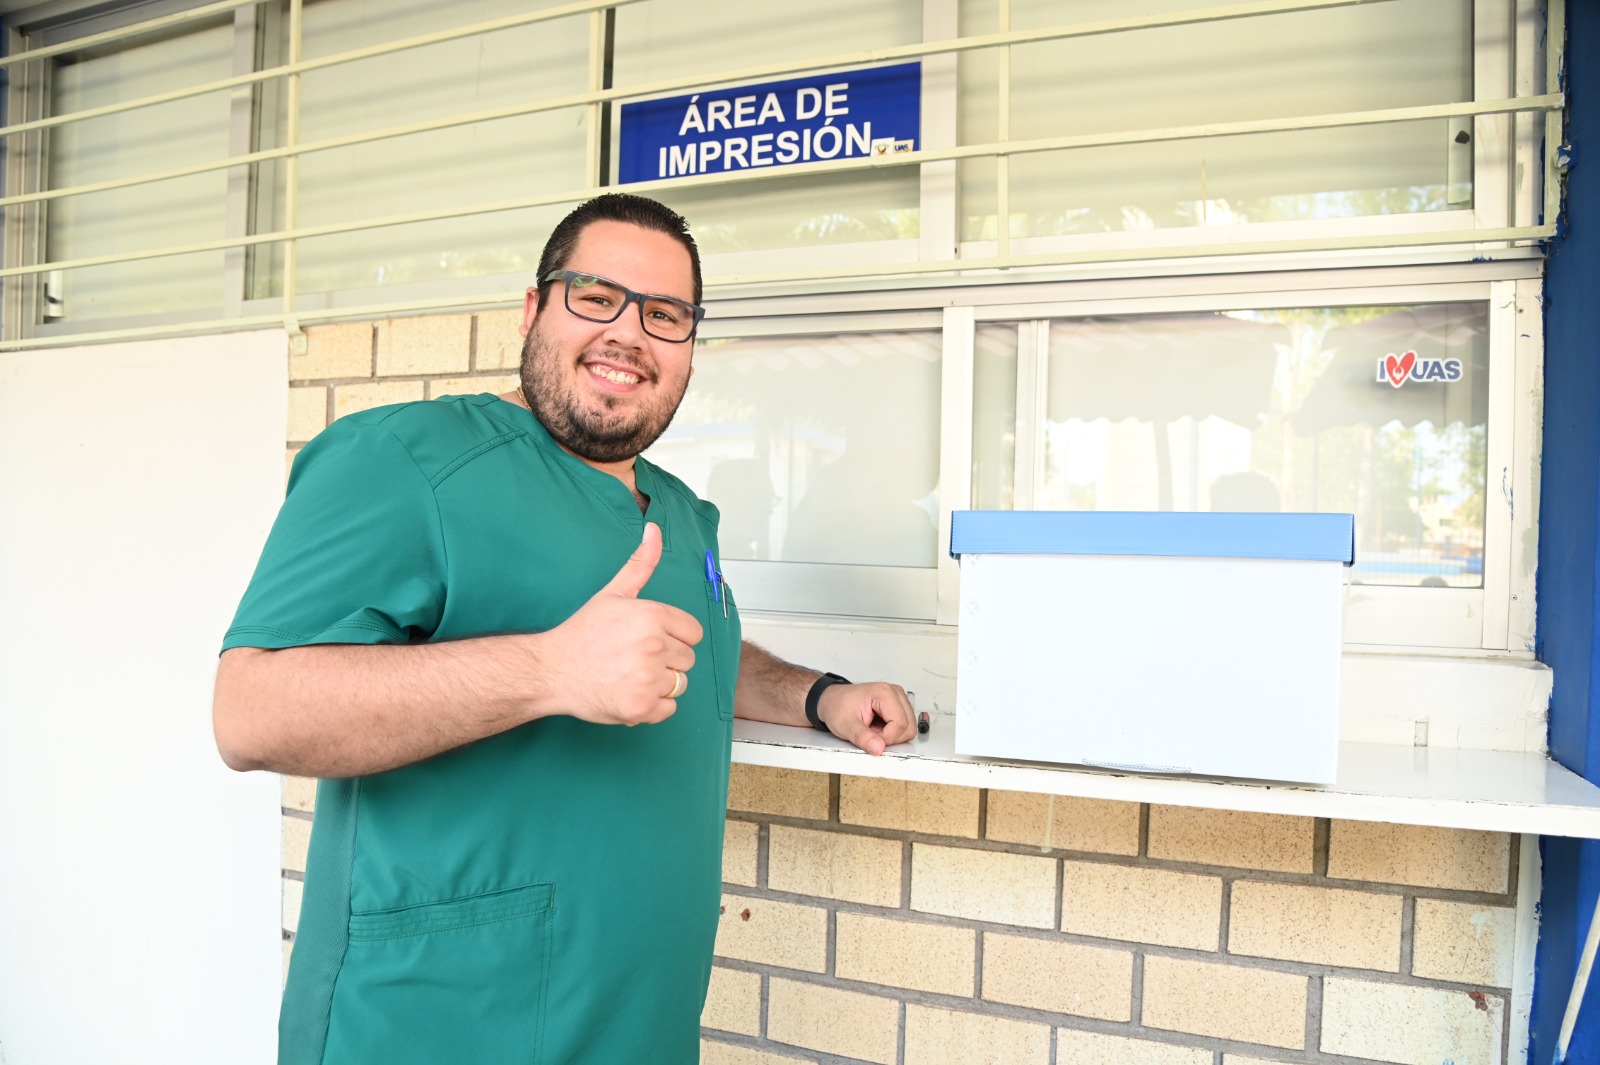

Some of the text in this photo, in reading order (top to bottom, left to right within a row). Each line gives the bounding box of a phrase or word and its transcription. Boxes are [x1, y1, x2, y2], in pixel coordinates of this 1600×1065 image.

[678, 82, 849, 135] ÁREA DE
[658, 117, 871, 177] IMPRESIÓN
[894, 143, 909, 152] UAS
[1379, 360, 1461, 380] I UAS
